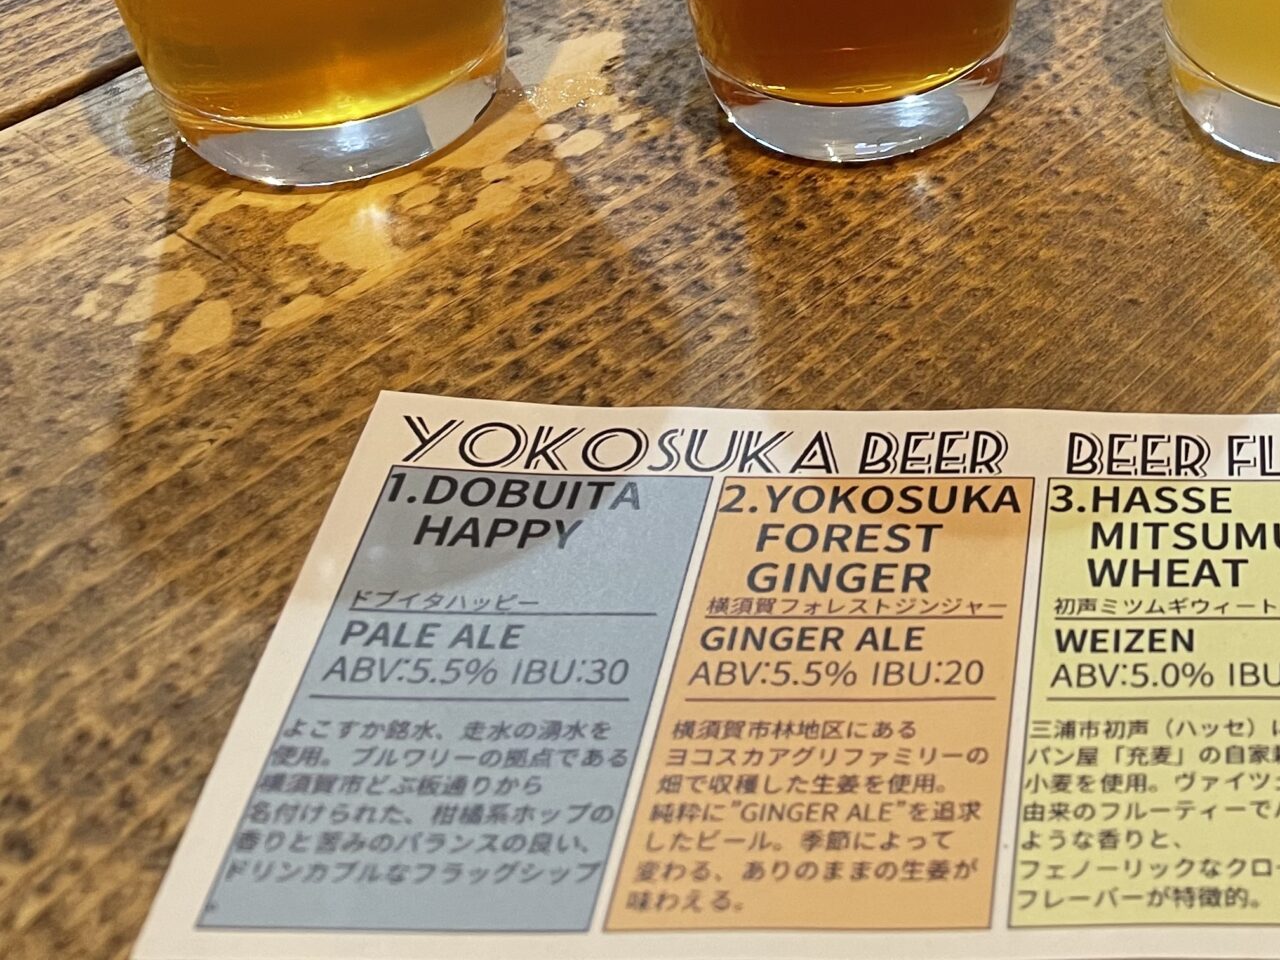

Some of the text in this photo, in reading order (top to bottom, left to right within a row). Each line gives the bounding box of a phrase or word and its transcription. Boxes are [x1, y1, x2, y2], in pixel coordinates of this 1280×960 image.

[402, 415, 839, 475] YOKOSUKA
[860, 432, 1008, 477] BEER
[1066, 432, 1210, 477] BEER
[385, 474, 642, 510] 1.DOBUITA
[717, 483, 1024, 516] 2.YOKOSUKA
[1050, 485, 1232, 514] 3.HASSE
[412, 516, 583, 550] HAPPY
[755, 522, 944, 554] FOREST
[746, 562, 933, 594] GINGER
[1086, 558, 1250, 588] WHEAT
[340, 621, 525, 650] PALE ALE
[700, 626, 927, 652] GINGER ALE
[1054, 628, 1196, 654] WEIZEN
[321, 656, 630, 686] ABV:5.5% IBU:30
[688, 658, 984, 687] ABV:5.5% IBU:20
[1050, 662, 1215, 689] ABV:5.0%
